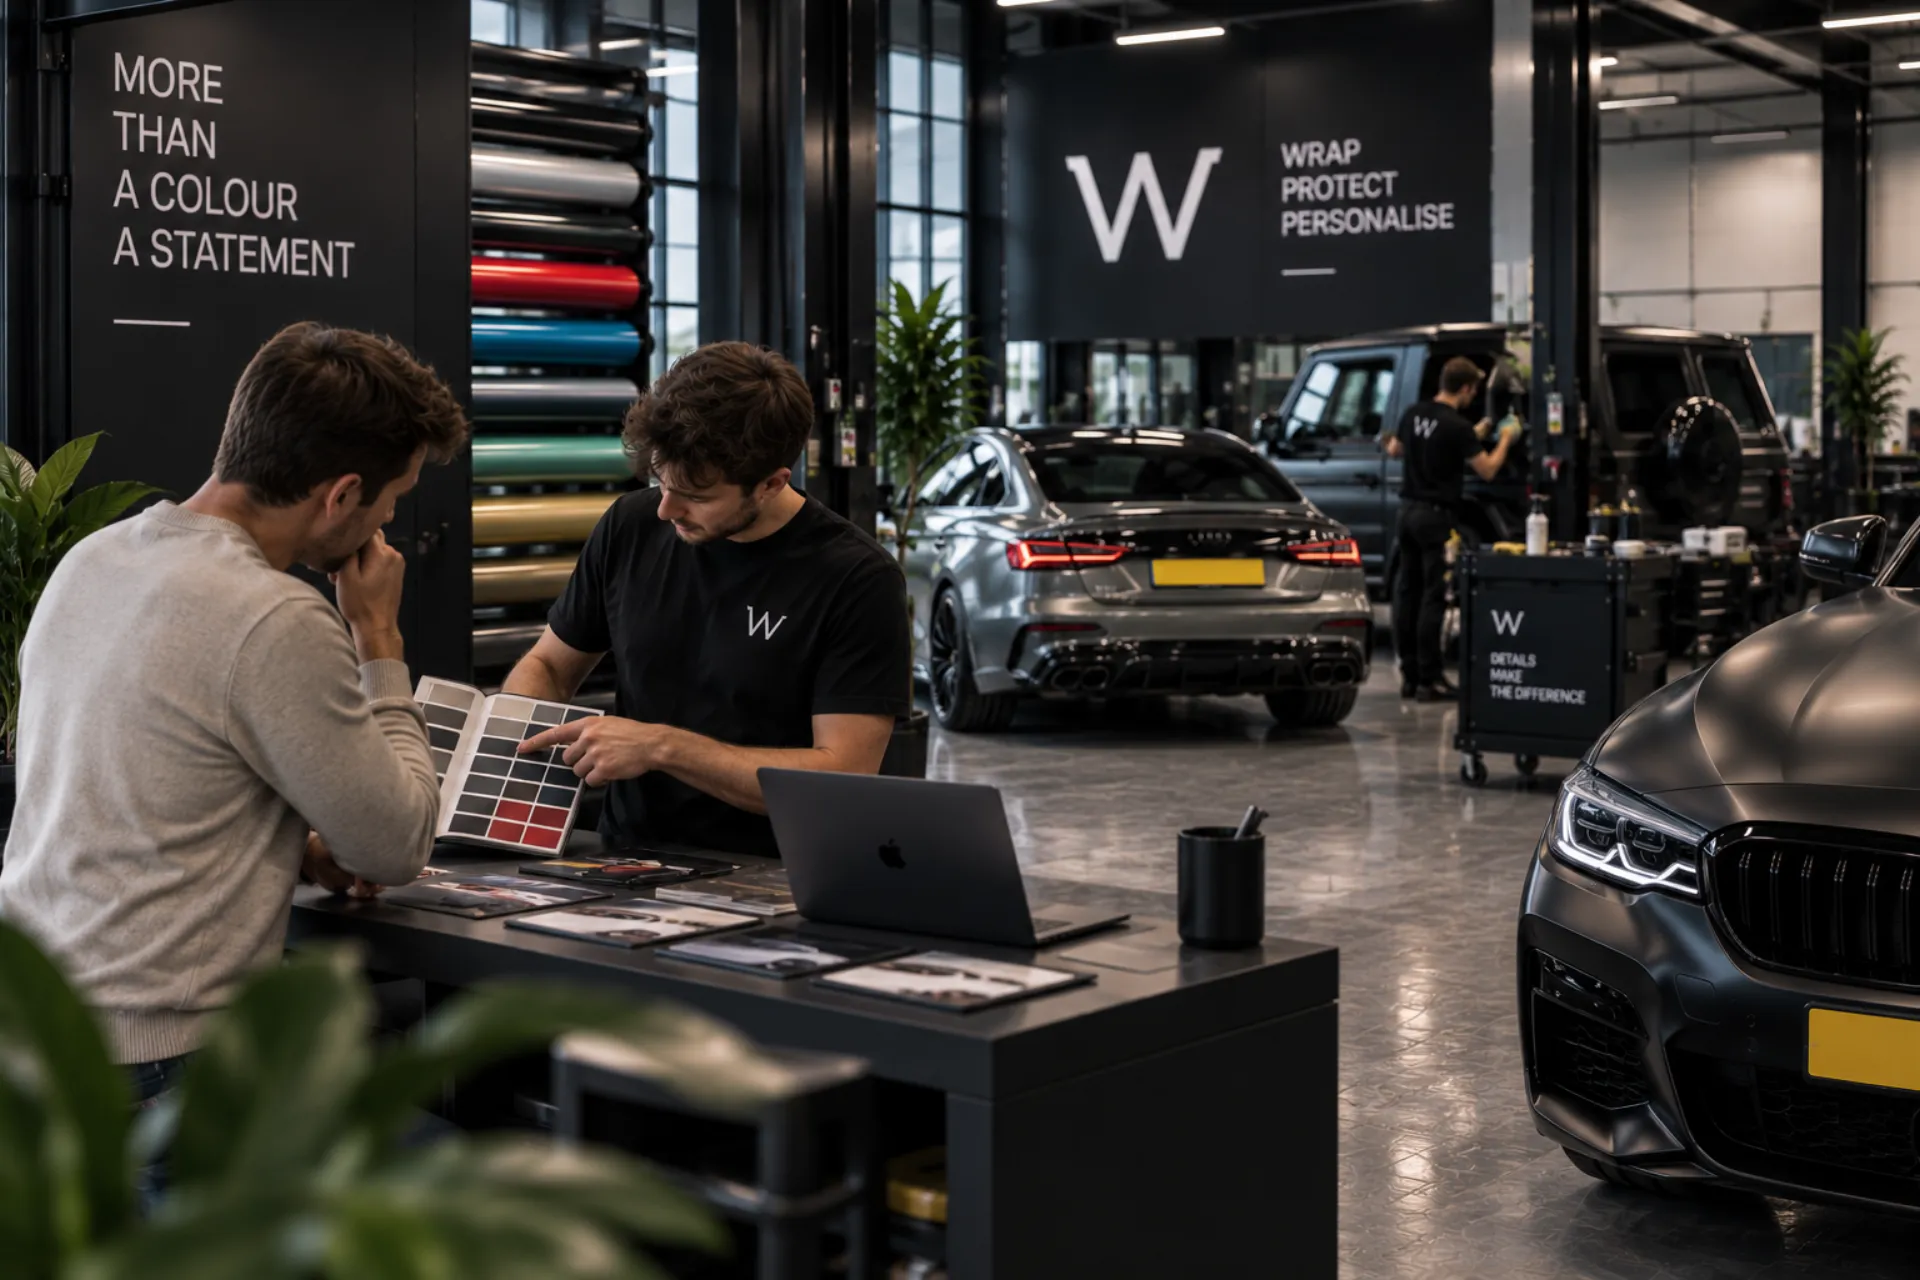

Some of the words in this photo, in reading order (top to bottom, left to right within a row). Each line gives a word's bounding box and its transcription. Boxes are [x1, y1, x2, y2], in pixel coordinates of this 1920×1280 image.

[114, 52, 224, 105] MORE
[113, 111, 216, 160] THAN
[1281, 138, 1361, 169] WRAP
[113, 169, 140, 209] A
[150, 171, 298, 222] COLOUR
[1281, 171, 1398, 203] PROTECT
[1065, 147, 1223, 263] W
[1281, 203, 1454, 237] PERSONALISE
[113, 227, 140, 267] A
[150, 229, 356, 279] STATEMENT
[1413, 415, 1438, 439] W
[746, 605, 788, 641] W
[1491, 609, 1525, 636] W
[1490, 652, 1537, 668] DETAILS
[1490, 668, 1523, 684] MAKE
[1490, 685, 1513, 700] THE
[1514, 687, 1586, 705] DIFFERENCE
